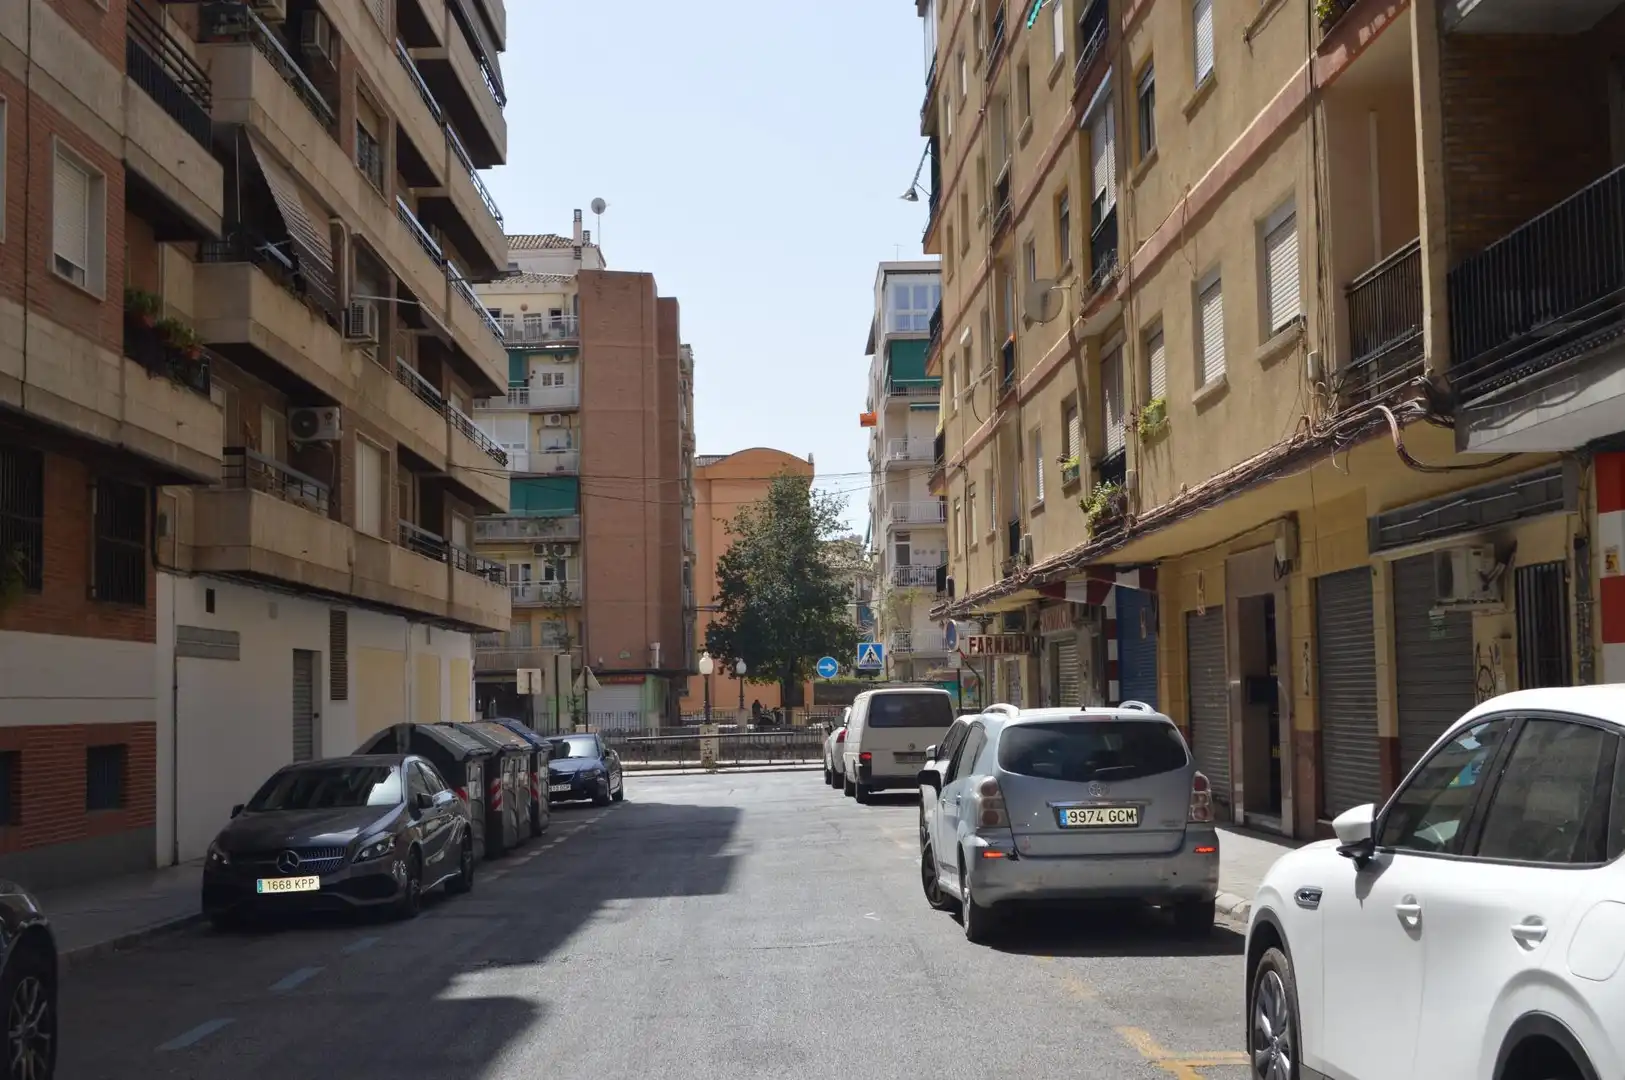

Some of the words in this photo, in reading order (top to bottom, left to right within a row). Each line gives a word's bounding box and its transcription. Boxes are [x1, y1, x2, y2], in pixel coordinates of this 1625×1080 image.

[1069, 810, 1104, 824] 9974
[1108, 809, 1135, 823] GCM
[267, 880, 292, 891] 1668
[295, 878, 315, 889] KPP
